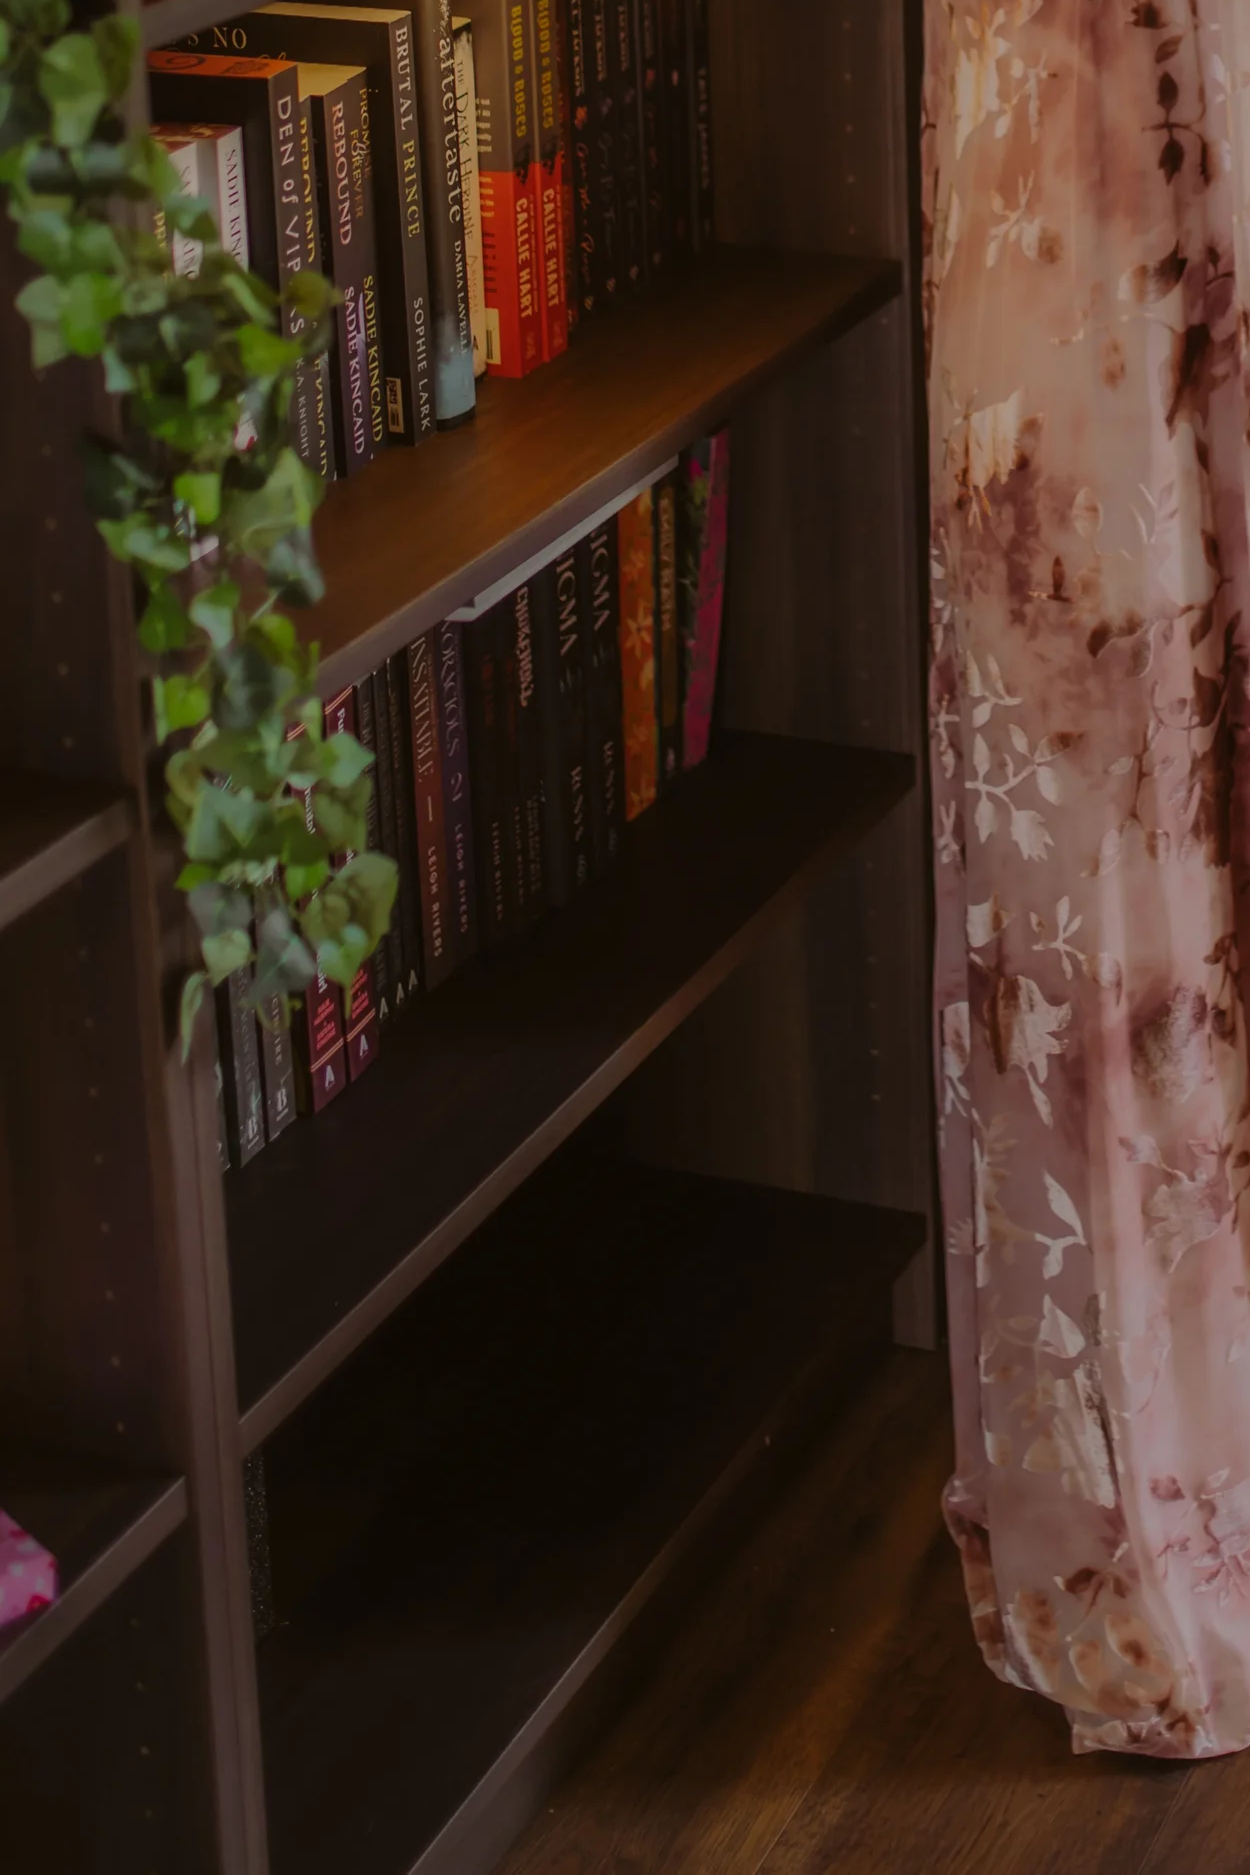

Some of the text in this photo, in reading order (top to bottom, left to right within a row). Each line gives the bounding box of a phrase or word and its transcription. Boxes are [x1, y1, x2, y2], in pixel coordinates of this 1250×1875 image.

[212, 26, 247, 50] NO
[456, 92, 470, 149] DARK
[225, 148, 241, 216] SADIE
[439, 37, 461, 224] aftertaste
[454, 240, 464, 290] DARIA
[277, 94, 305, 334] DEN of VIPS
[395, 25, 431, 431] BRUTAL PRINCE SOPHIE LARK
[516, 197, 530, 266] CALLIE
[543, 187, 558, 256] CALLIE
[331, 100, 365, 456] REBOUND SADIE KINCAID
[519, 268, 533, 319] HART
[546, 257, 559, 308] HART
[363, 275, 384, 443] SADIE KINCAID
[298, 392, 310, 459] KNIGHT
[555, 551, 579, 657] IGMA
[590, 525, 611, 631] IGMA
[410, 636, 443, 957] INSATIABLE LEIGH RIVERS
[455, 823, 465, 872] LEIGH
[457, 877, 469, 934] RIVERS
